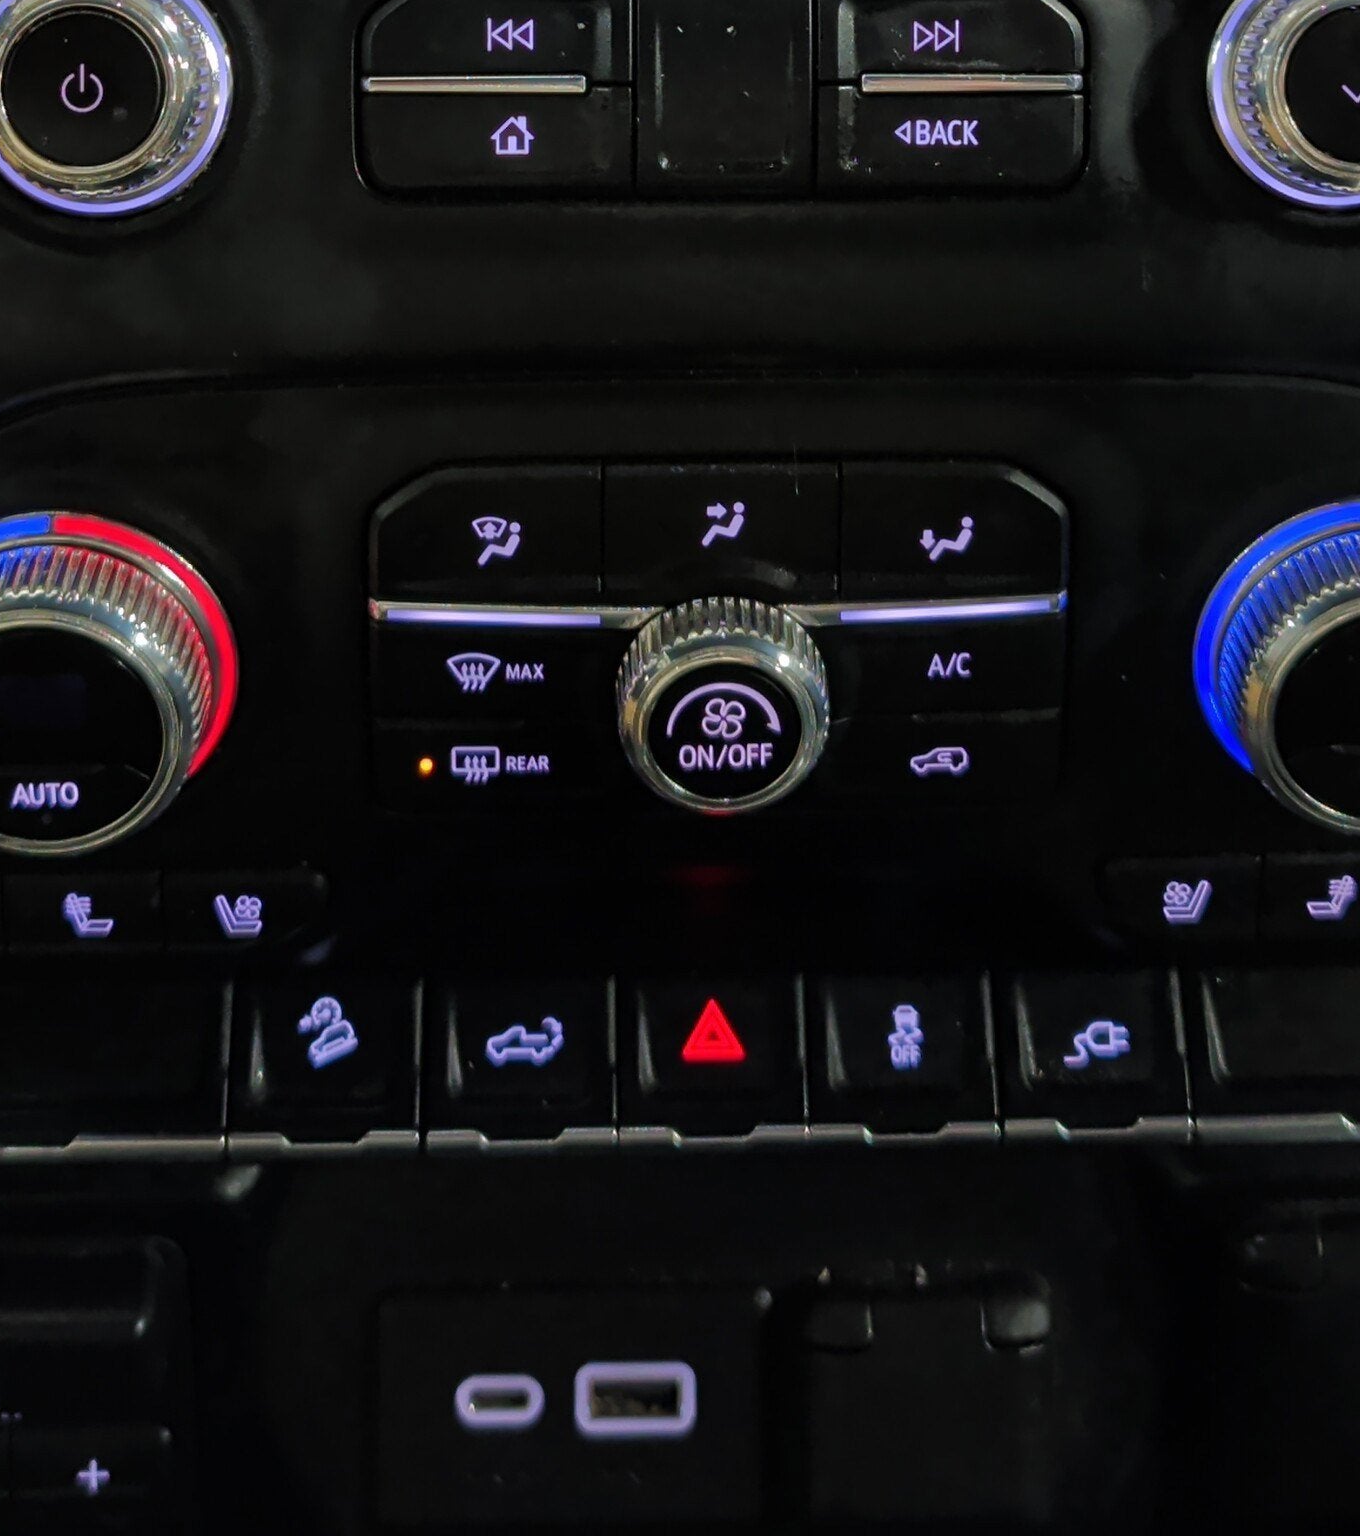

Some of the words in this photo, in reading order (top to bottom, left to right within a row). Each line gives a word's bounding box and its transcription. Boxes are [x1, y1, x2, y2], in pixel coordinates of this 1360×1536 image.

[915, 119, 979, 146] BACK
[505, 663, 544, 680] MAX
[927, 651, 970, 677] A/C
[505, 755, 549, 772] REAR
[679, 743, 773, 770] ON/OFF
[11, 781, 79, 808] AUTO
